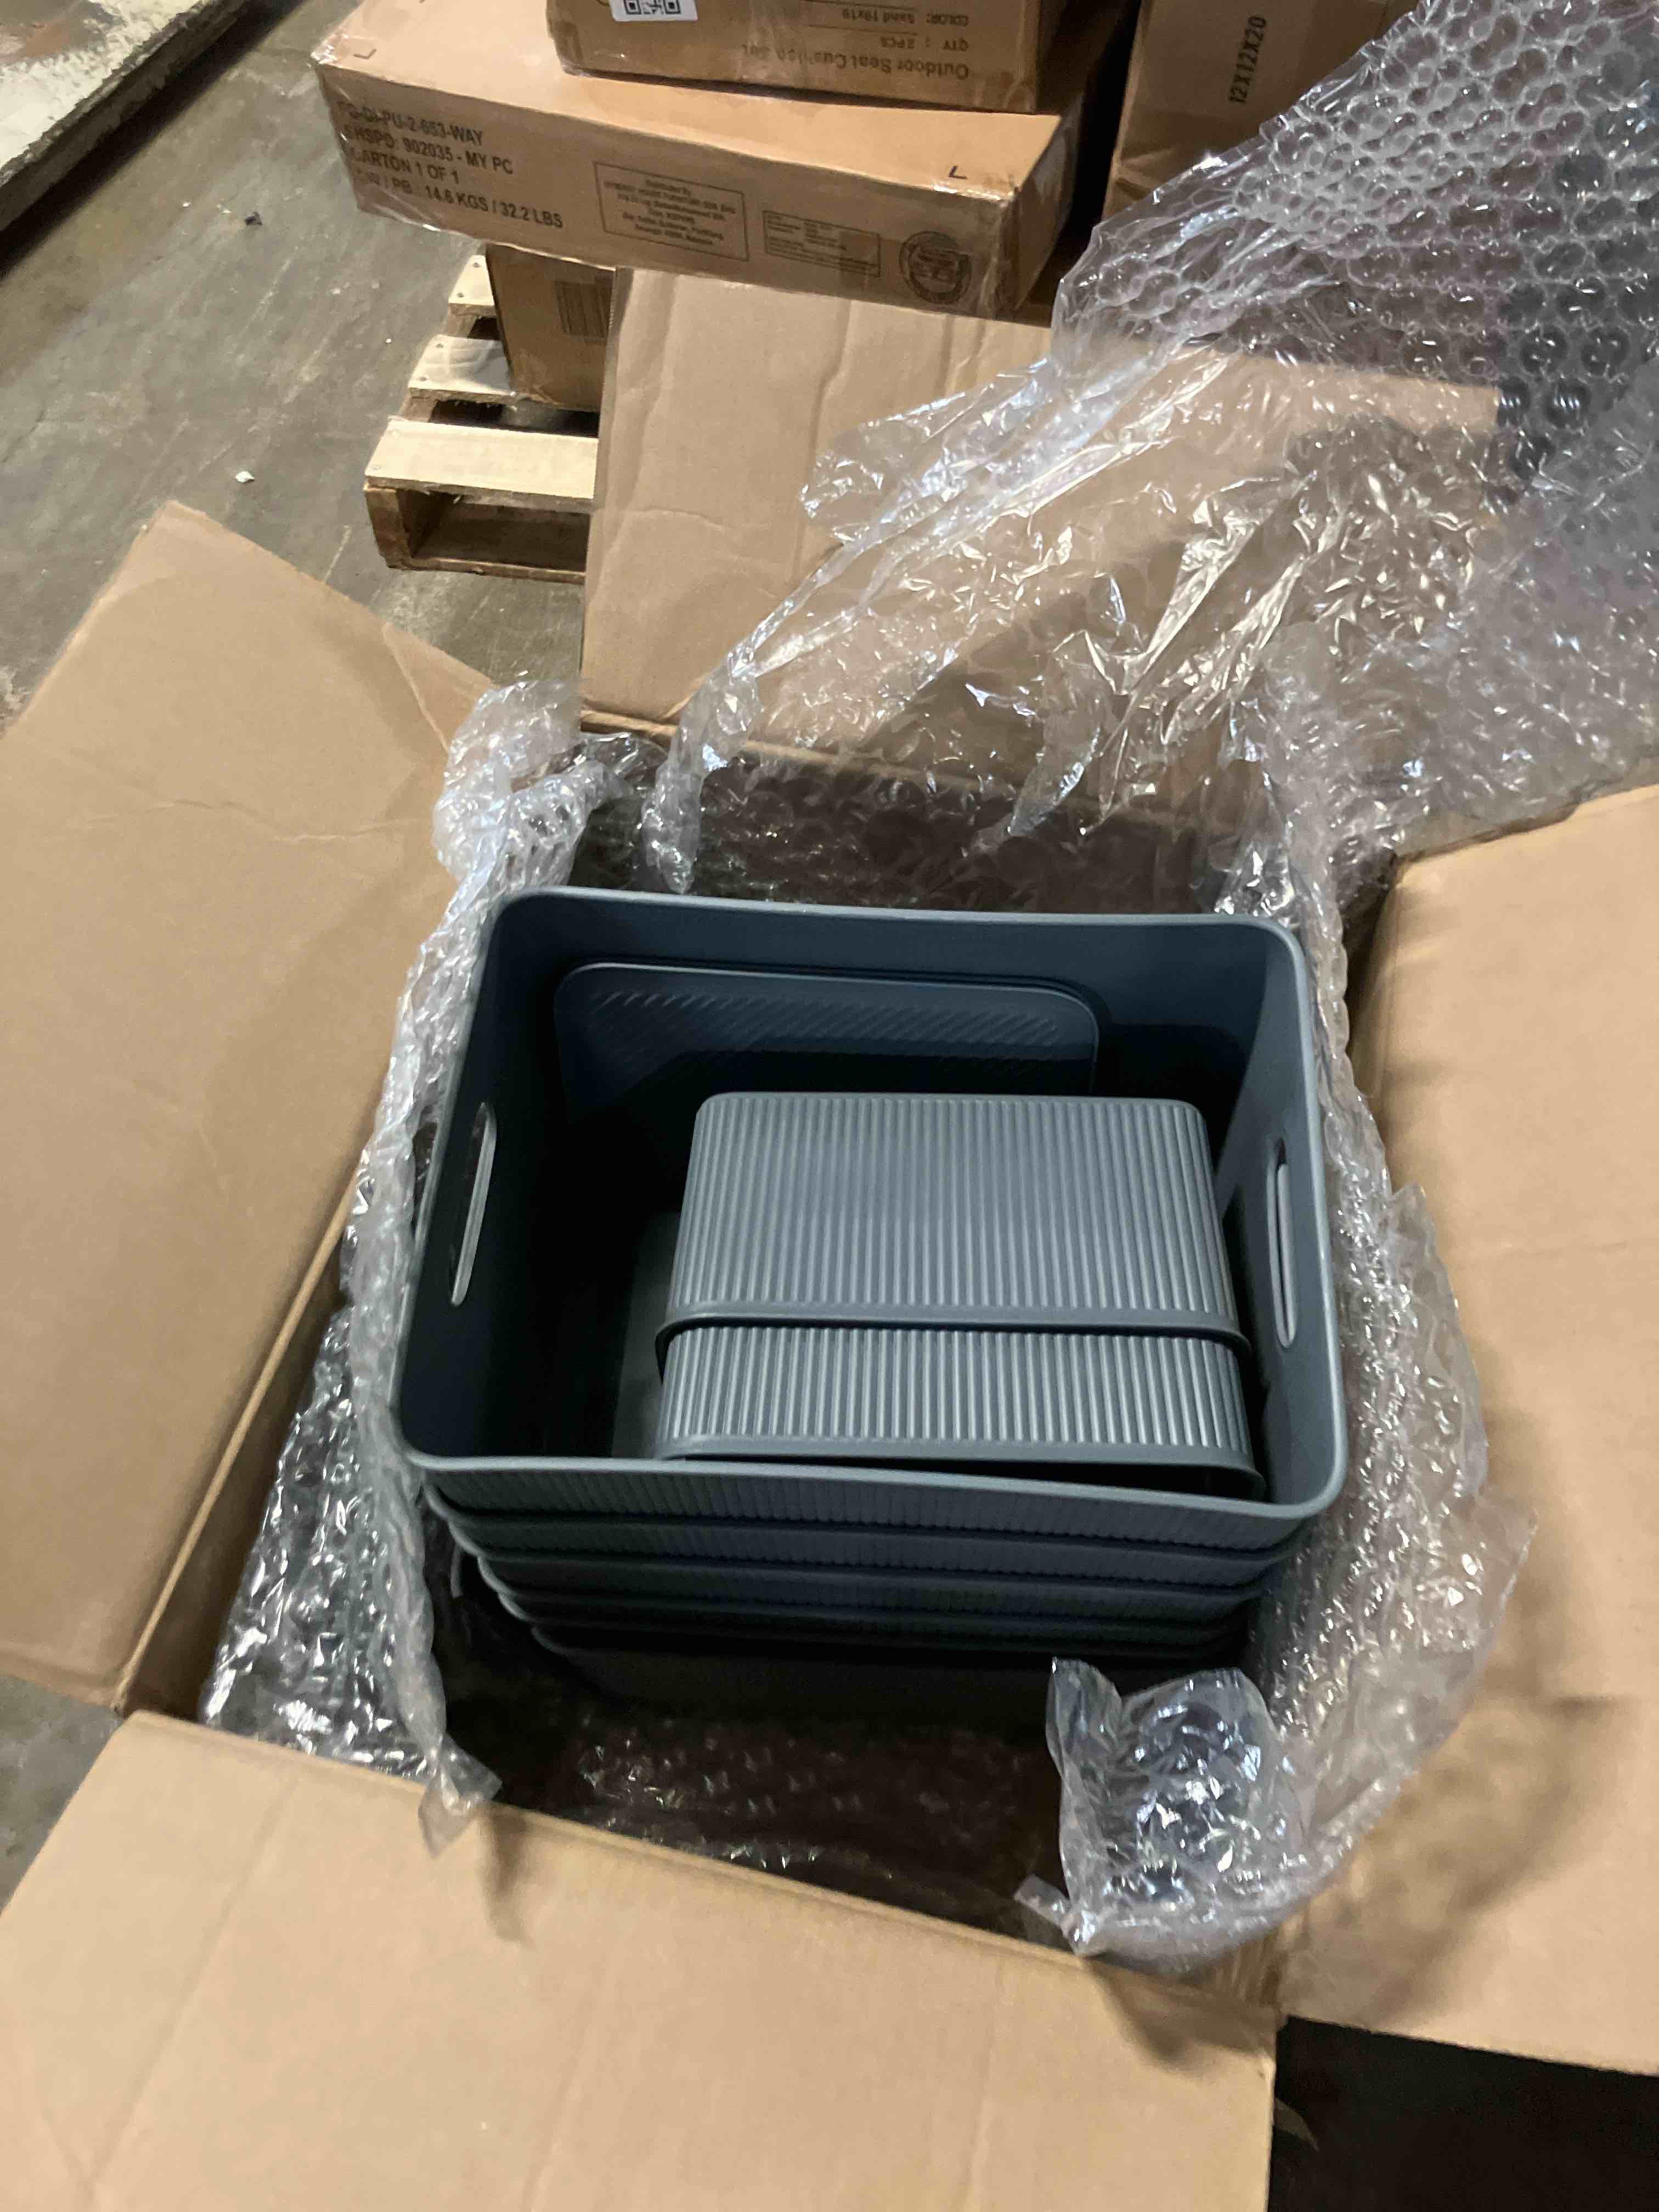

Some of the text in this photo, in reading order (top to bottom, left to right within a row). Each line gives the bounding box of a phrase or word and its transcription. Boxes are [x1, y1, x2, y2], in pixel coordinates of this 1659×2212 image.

[943, 36, 969, 52] QTY
[850, 54, 892, 74] Seat
[896, 57, 969, 80] Outdoor
[402, 137, 454, 161] 902035
[465, 150, 487, 170] MY
[492, 156, 514, 175] PC
[415, 161, 423, 176] 1
[426, 164, 446, 181] OF
[452, 167, 459, 184] 1
[532, 208, 562, 228] LBS
